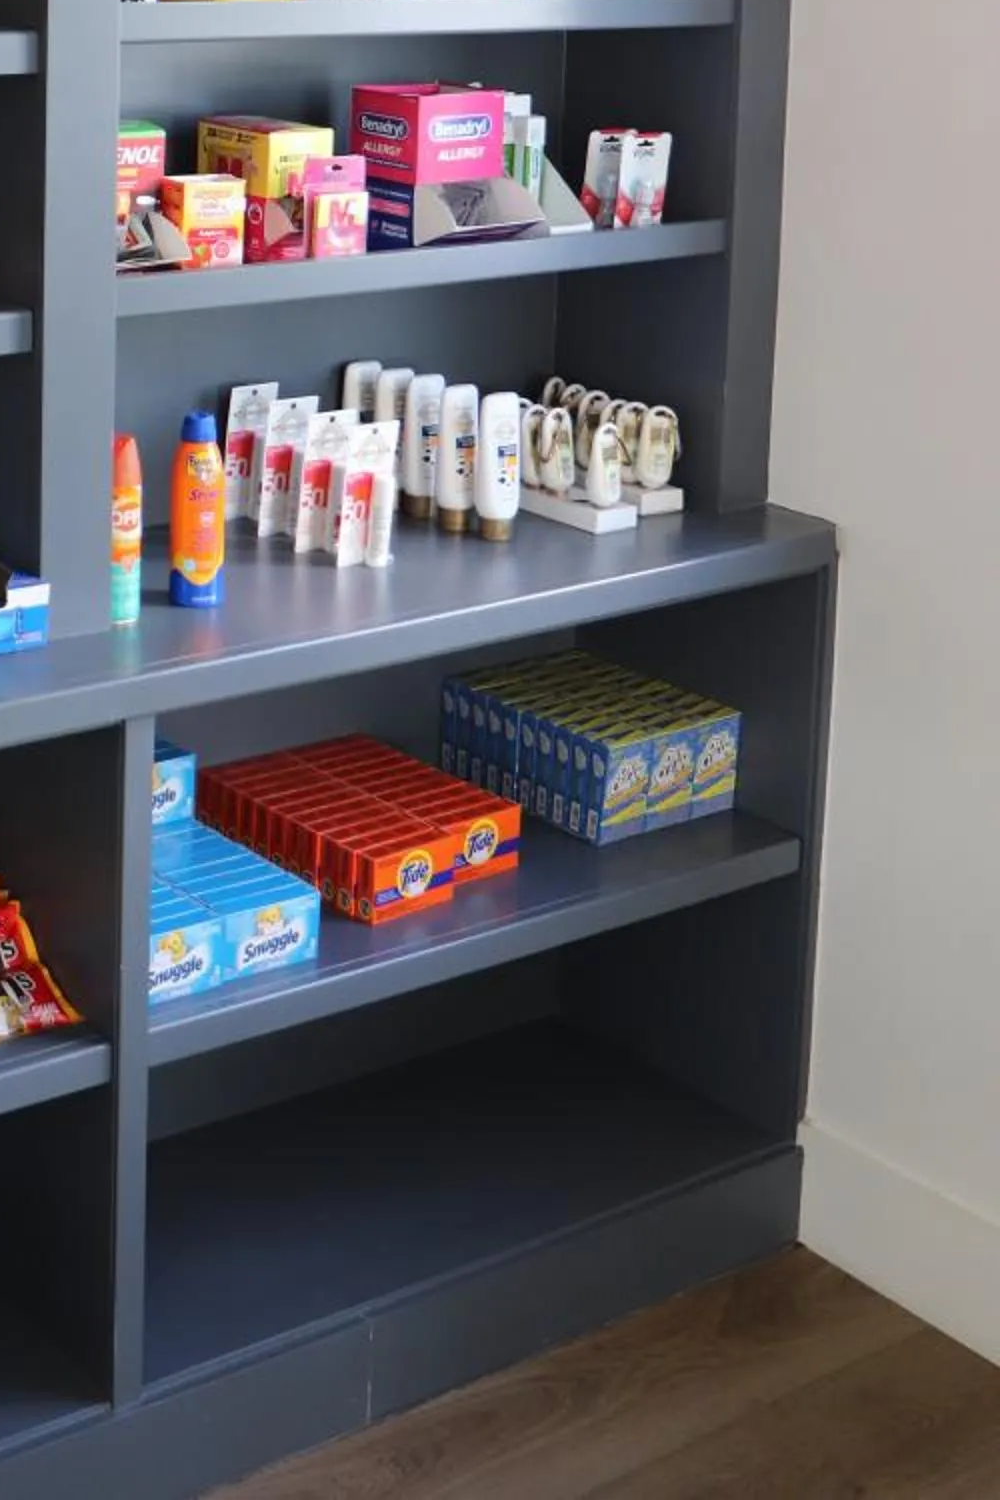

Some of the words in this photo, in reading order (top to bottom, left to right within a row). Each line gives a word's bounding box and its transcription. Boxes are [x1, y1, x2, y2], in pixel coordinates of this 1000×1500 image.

[361, 115, 404, 138] Benadryl
[433, 117, 489, 138] Benadryl
[466, 831, 495, 860] Tide
[402, 861, 430, 894] Tide
[243, 928, 300, 963] Snuggle
[148, 955, 204, 987] Snuggle
